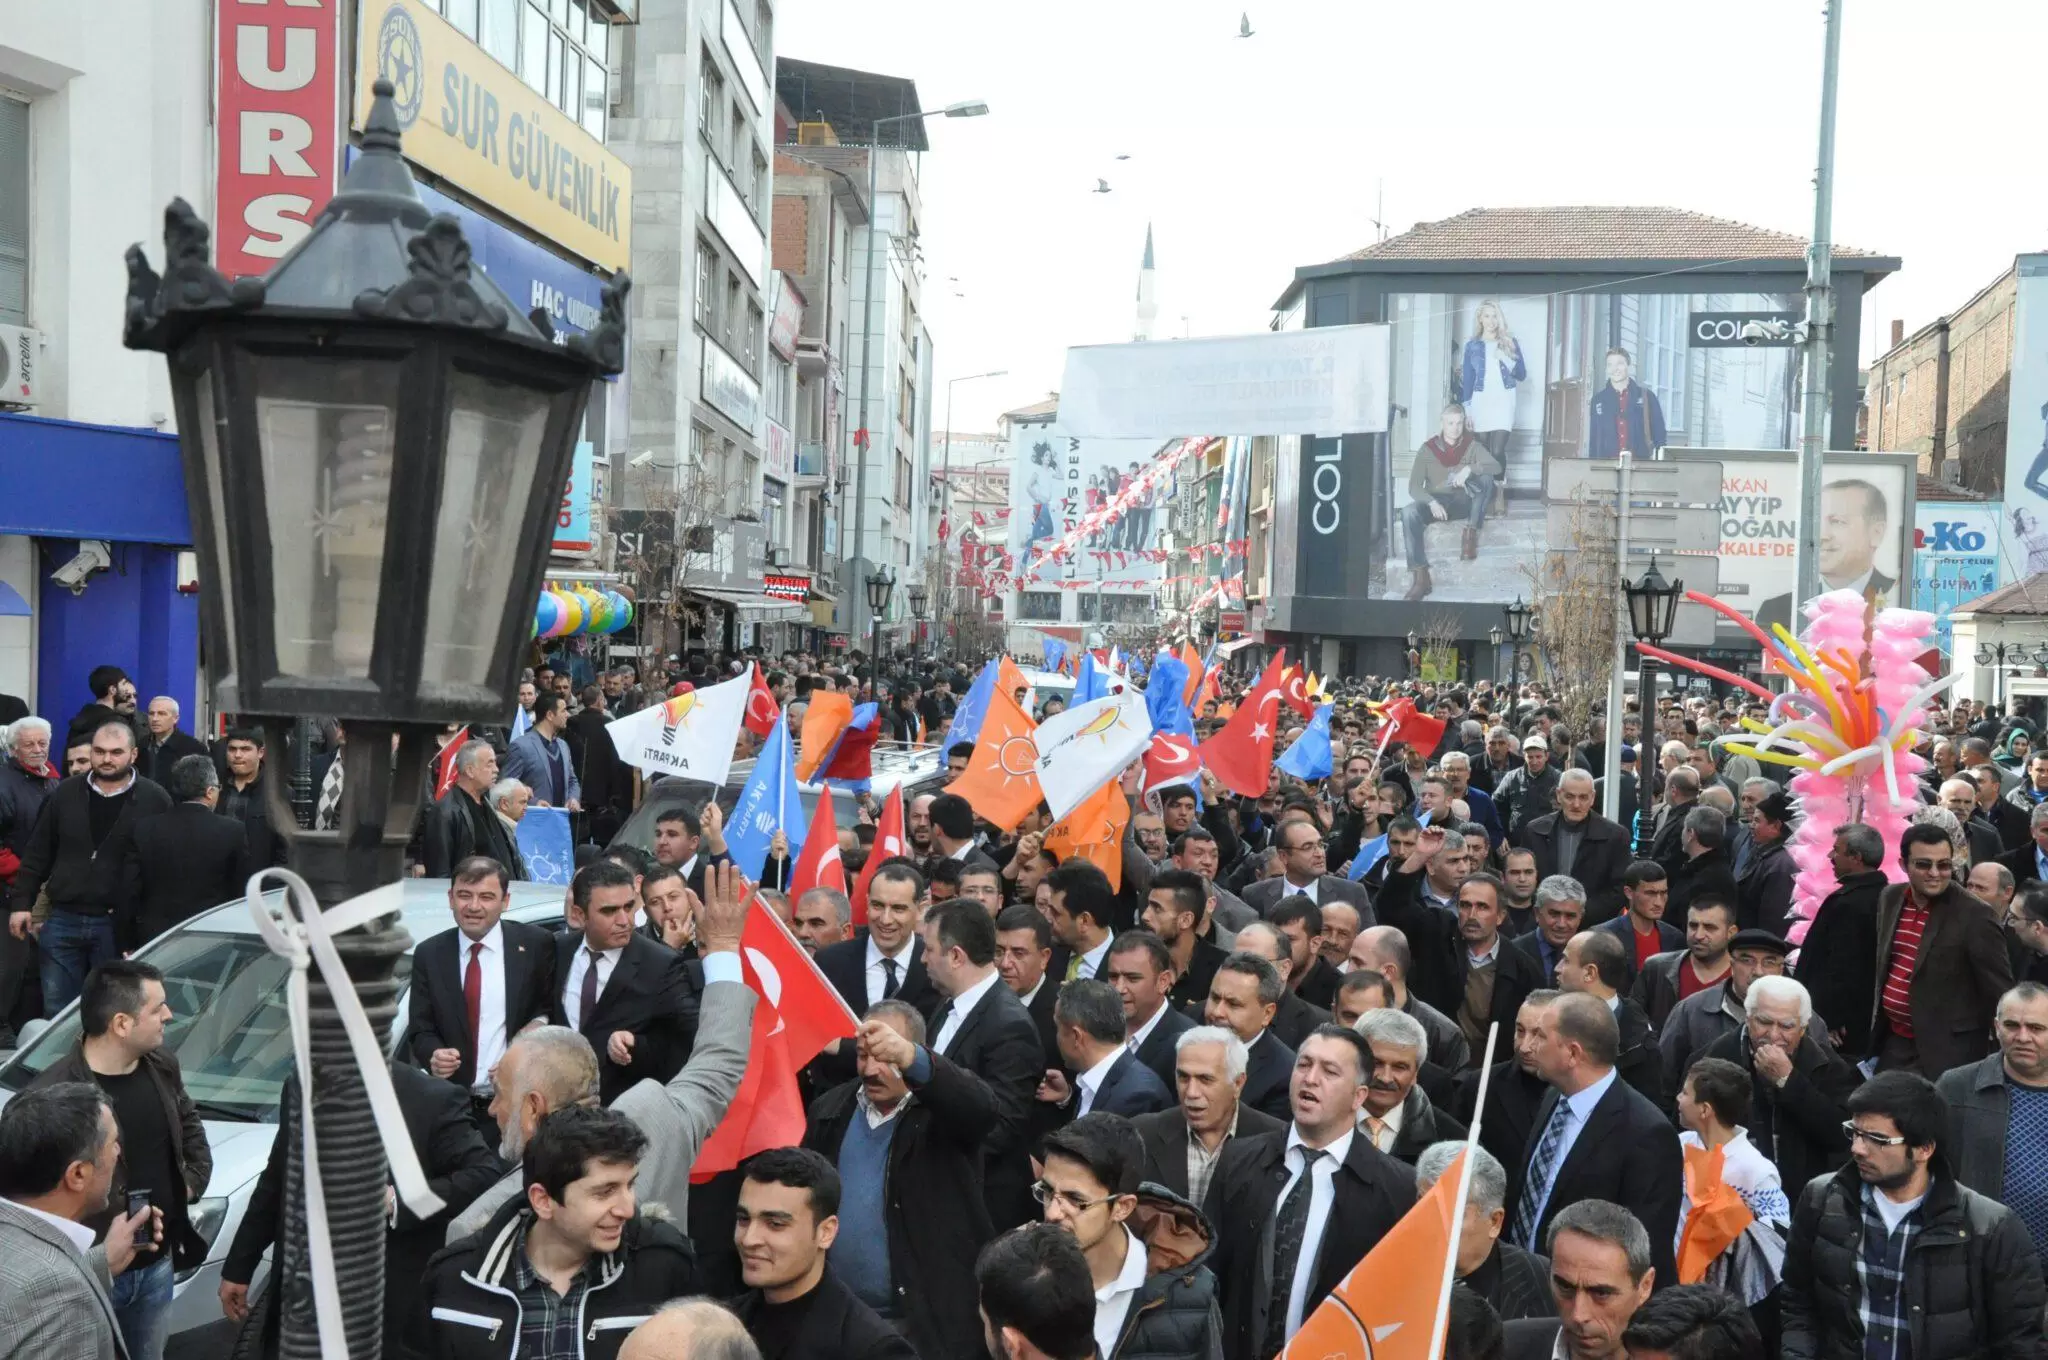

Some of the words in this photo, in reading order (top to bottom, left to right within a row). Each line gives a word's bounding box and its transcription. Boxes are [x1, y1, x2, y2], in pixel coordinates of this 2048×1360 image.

[236, 0, 326, 285] URS
[441, 61, 499, 168] SUR
[508, 110, 620, 243] GÜVENLİK
[20, 333, 32, 382] arçelik
[1312, 434, 1342, 535] COL
[1721, 478, 1768, 493] AKAN
[1717, 495, 1782, 515] AYYİP
[1721, 515, 1796, 538] OĞAN
[749, 780, 768, 801] AK
